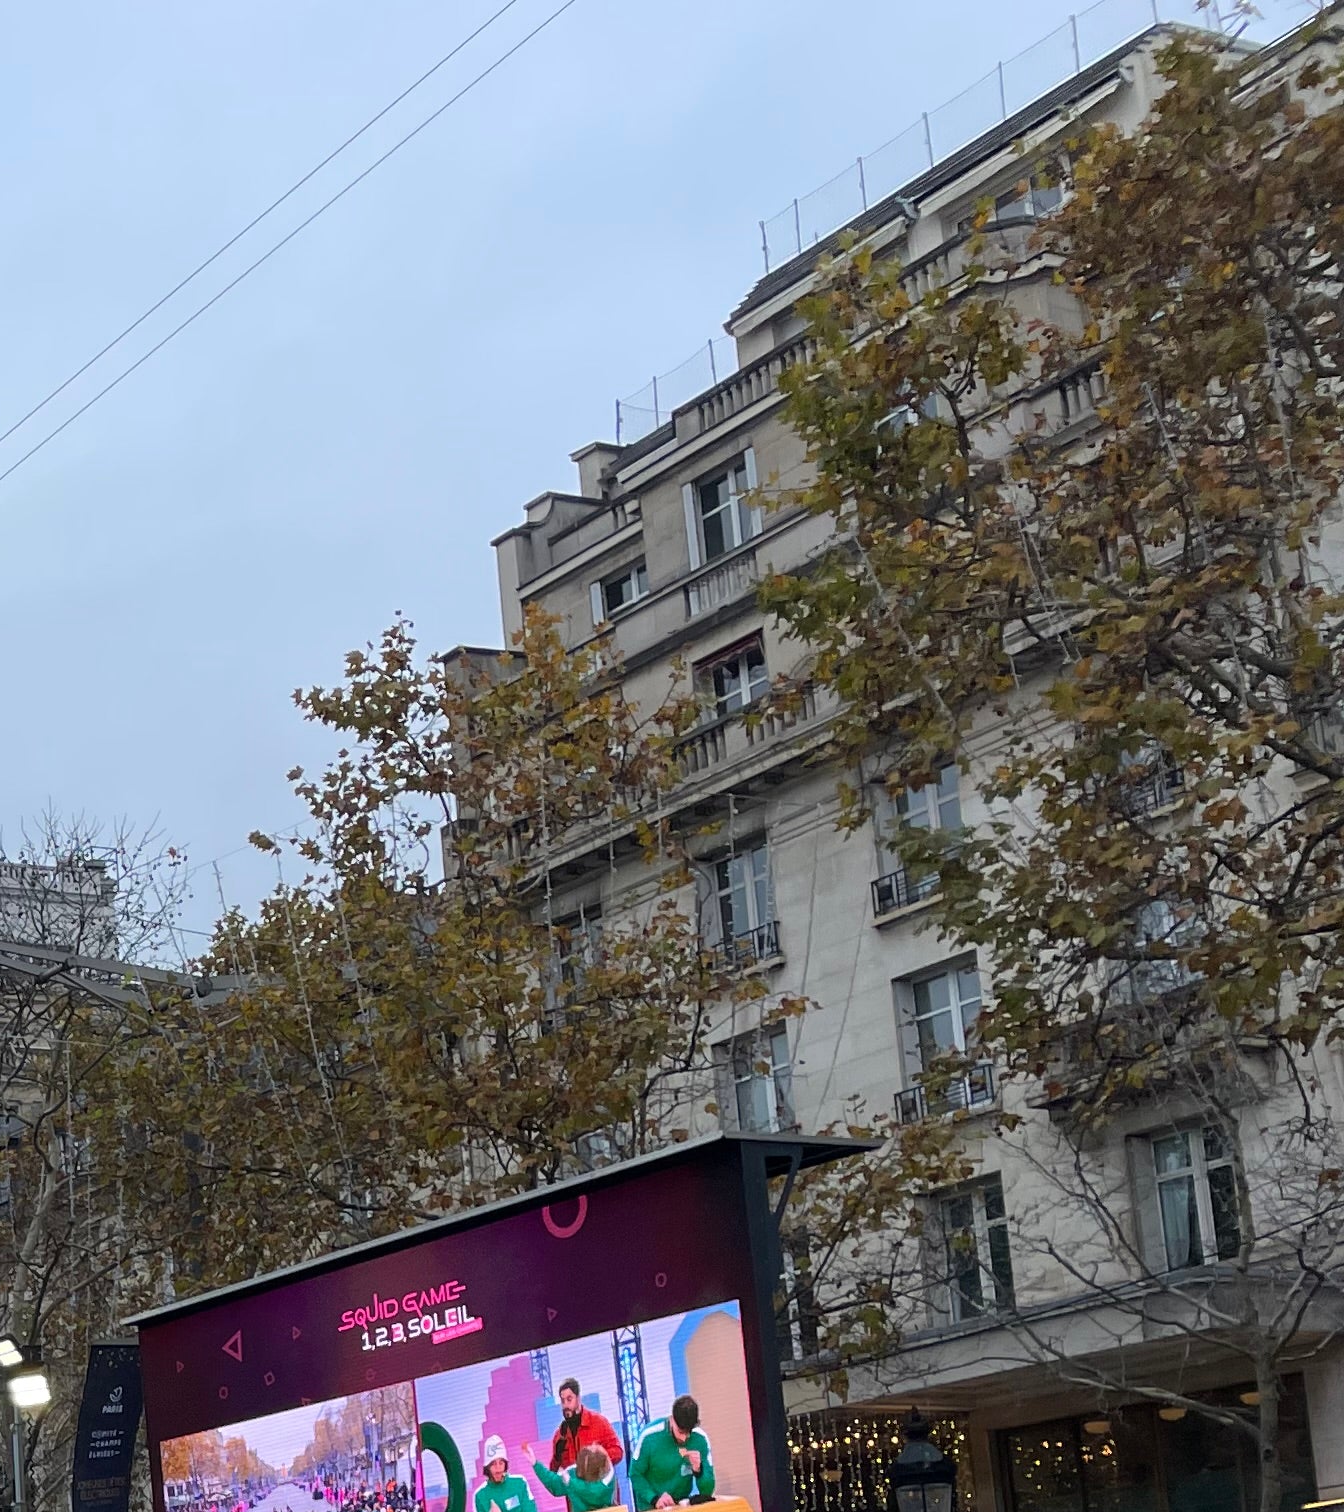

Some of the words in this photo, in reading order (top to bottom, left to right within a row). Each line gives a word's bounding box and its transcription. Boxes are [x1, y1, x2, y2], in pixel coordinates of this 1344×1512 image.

[338, 1293, 399, 1331] SQUID
[402, 1280, 466, 1317] GAME
[407, 1305, 475, 1338] SOLEIL
